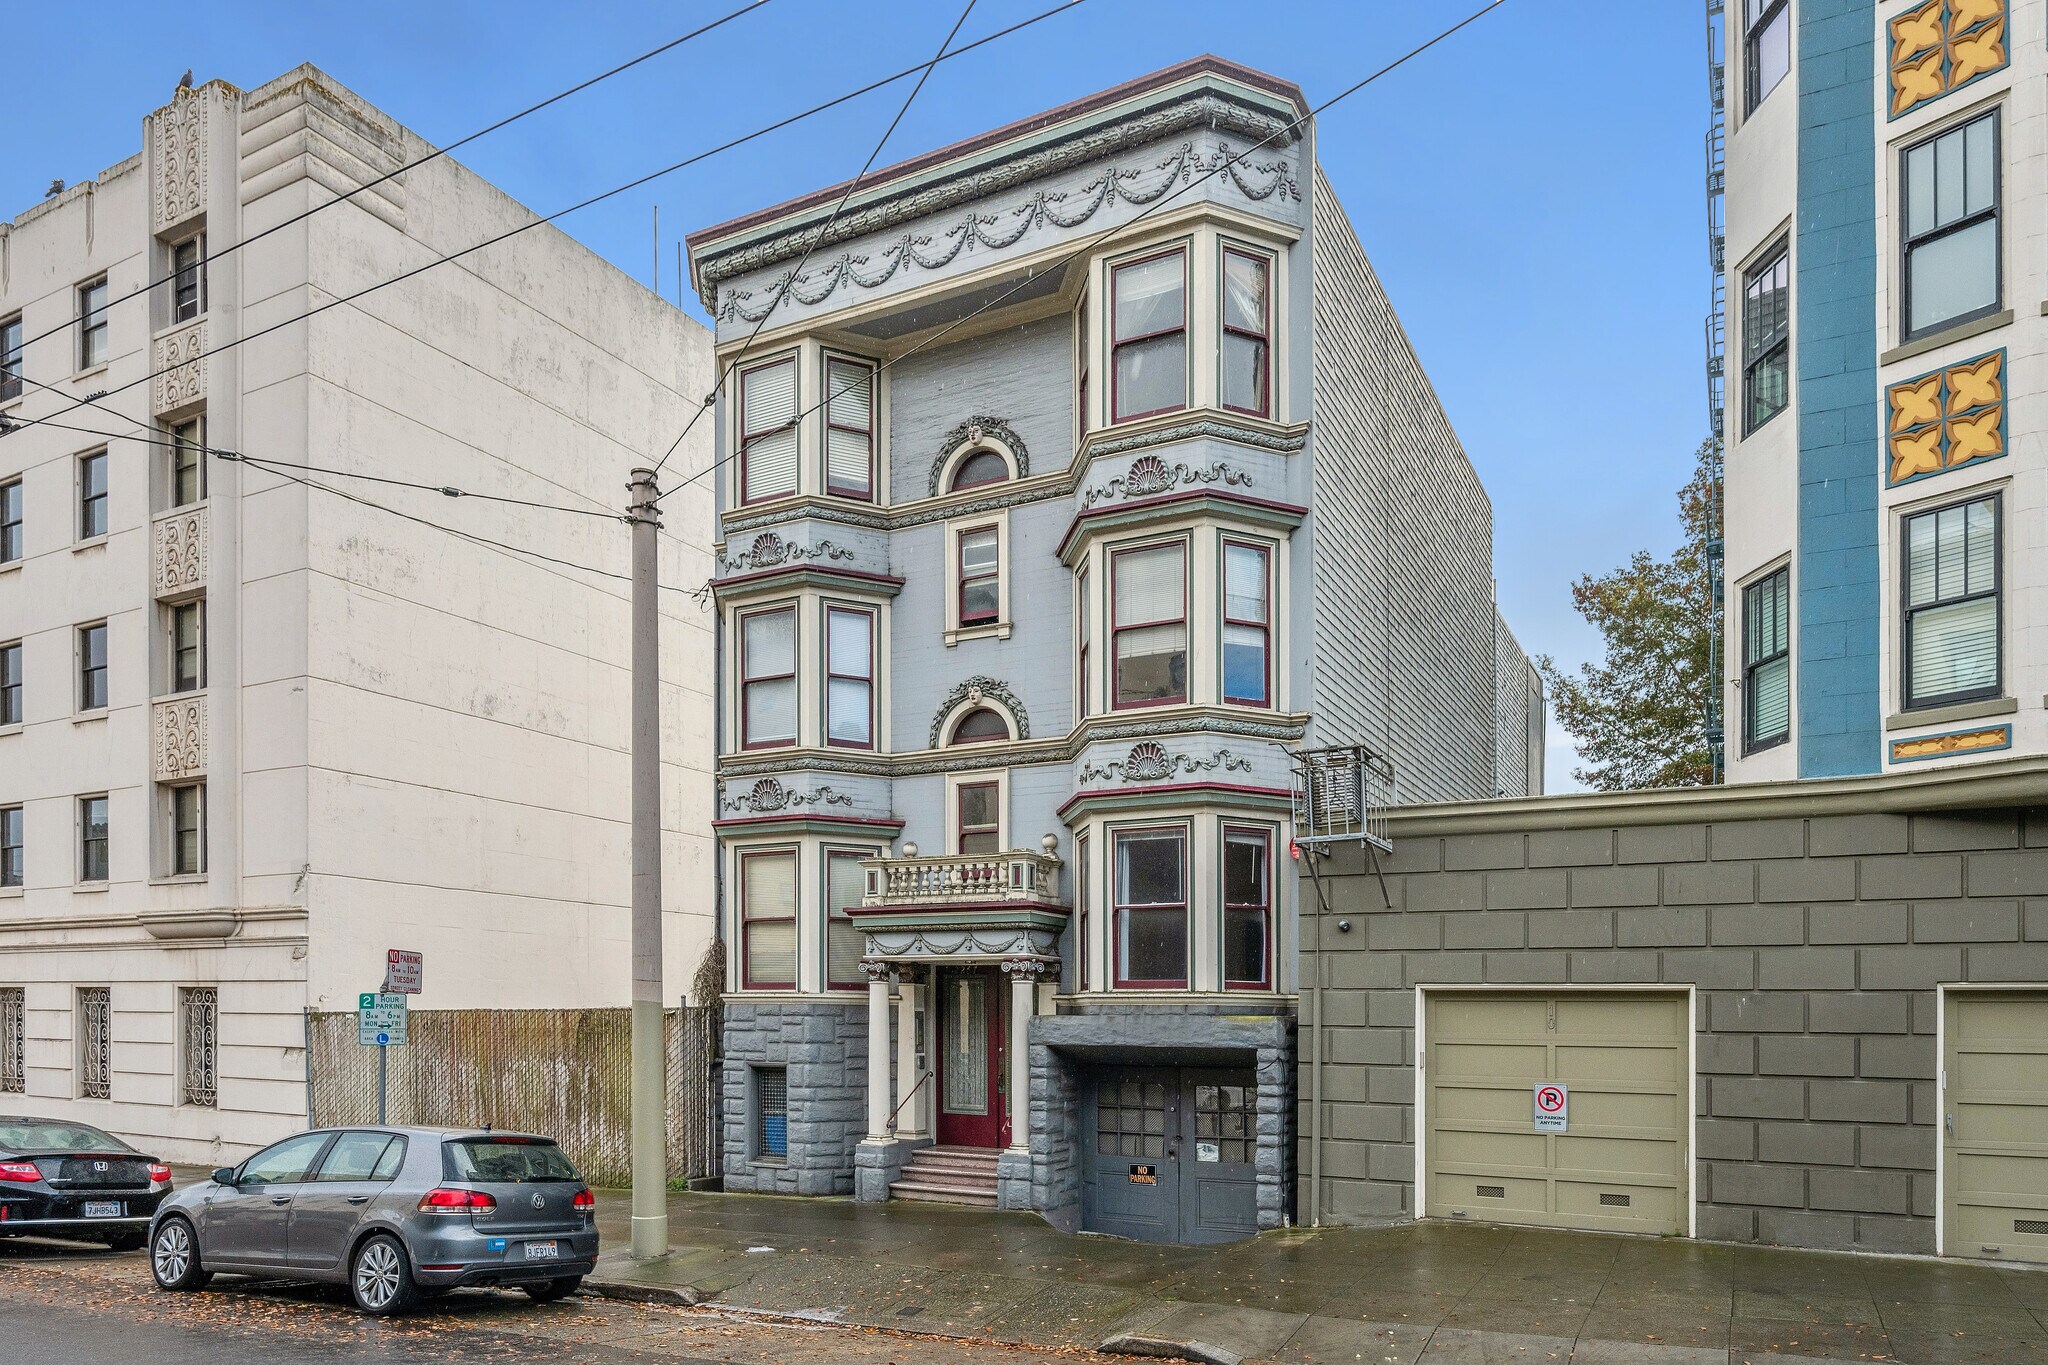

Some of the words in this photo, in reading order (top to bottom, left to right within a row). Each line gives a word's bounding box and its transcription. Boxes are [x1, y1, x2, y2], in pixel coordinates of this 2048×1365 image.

[389, 950, 399, 962] NO
[400, 954, 421, 965] PARKING
[393, 976, 417, 985] TUESDAY
[363, 995, 372, 1007] 2
[1137, 1166, 1147, 1174] NO
[1130, 1175, 1155, 1184] PARKING
